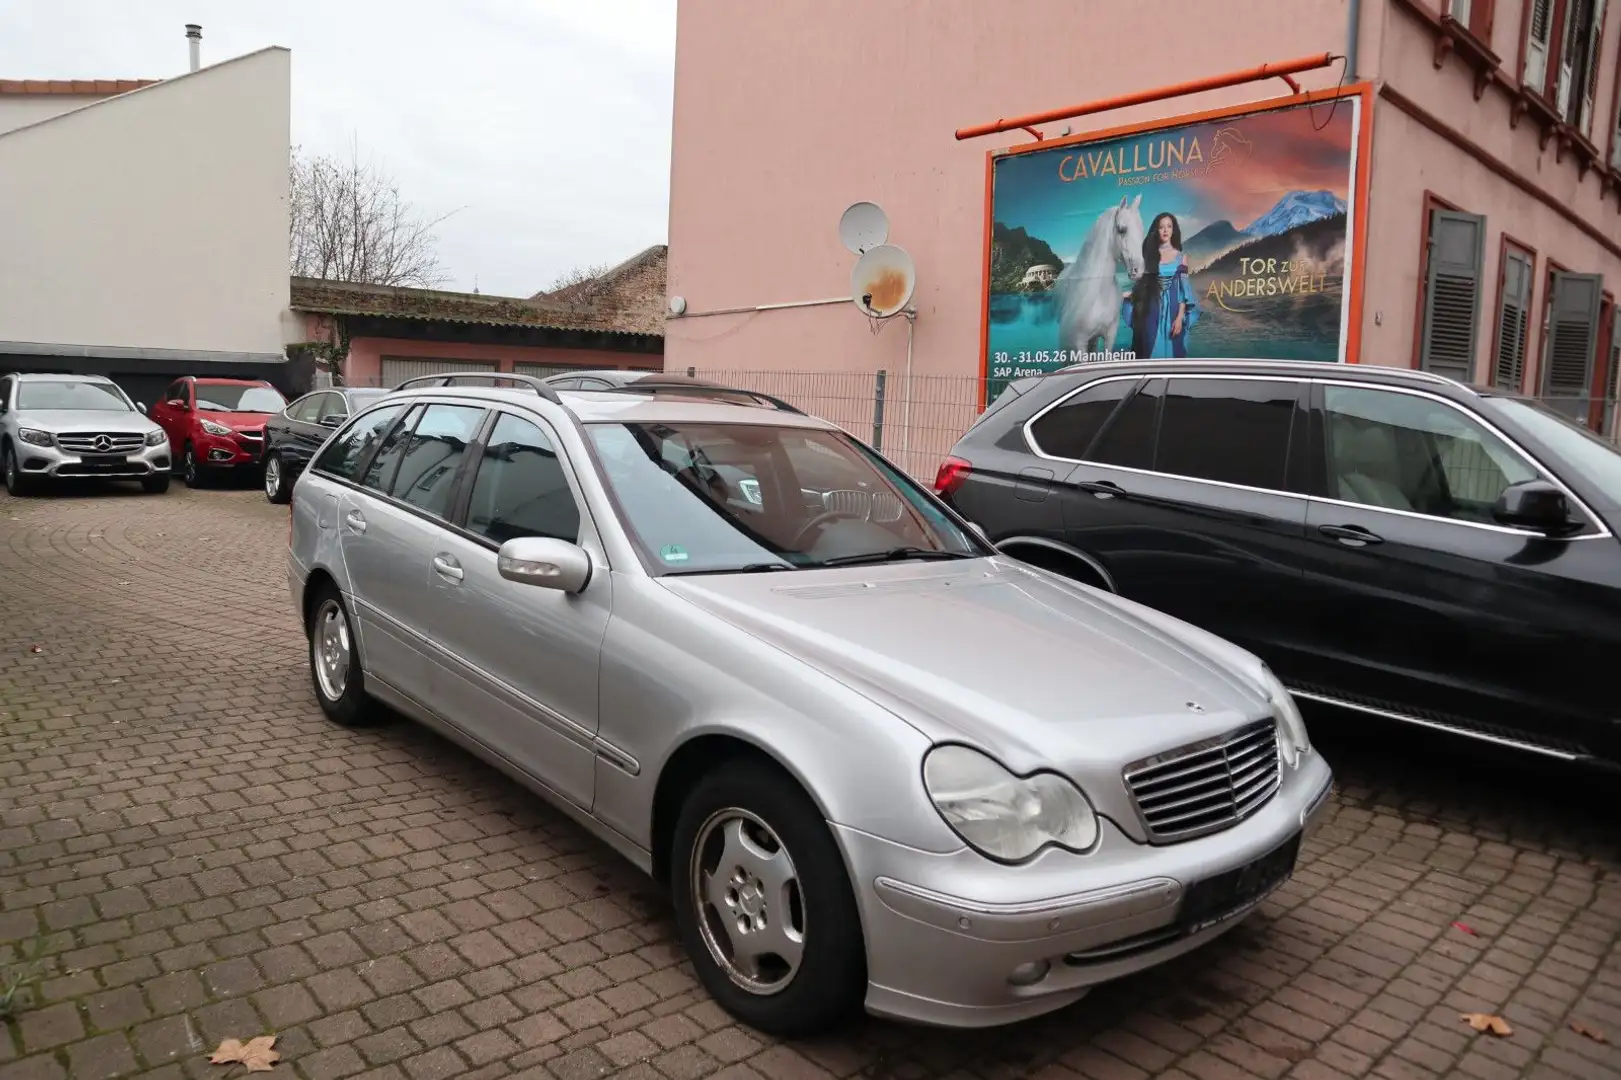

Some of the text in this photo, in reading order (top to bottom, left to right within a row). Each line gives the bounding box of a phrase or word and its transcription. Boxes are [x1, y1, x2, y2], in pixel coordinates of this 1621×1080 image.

[1058, 135, 1203, 182] CAVALLUNA
[1118, 175, 1150, 186] PASSION
[1153, 172, 1169, 182] FOR
[1240, 257, 1277, 275] TOR
[1206, 273, 1326, 312] ANDERSWELT
[994, 351, 1011, 363] 30.
[1018, 350, 1067, 363] 31.05.26
[1070, 348, 1136, 362] Mannheim
[993, 366, 1043, 377] SAP Arena
